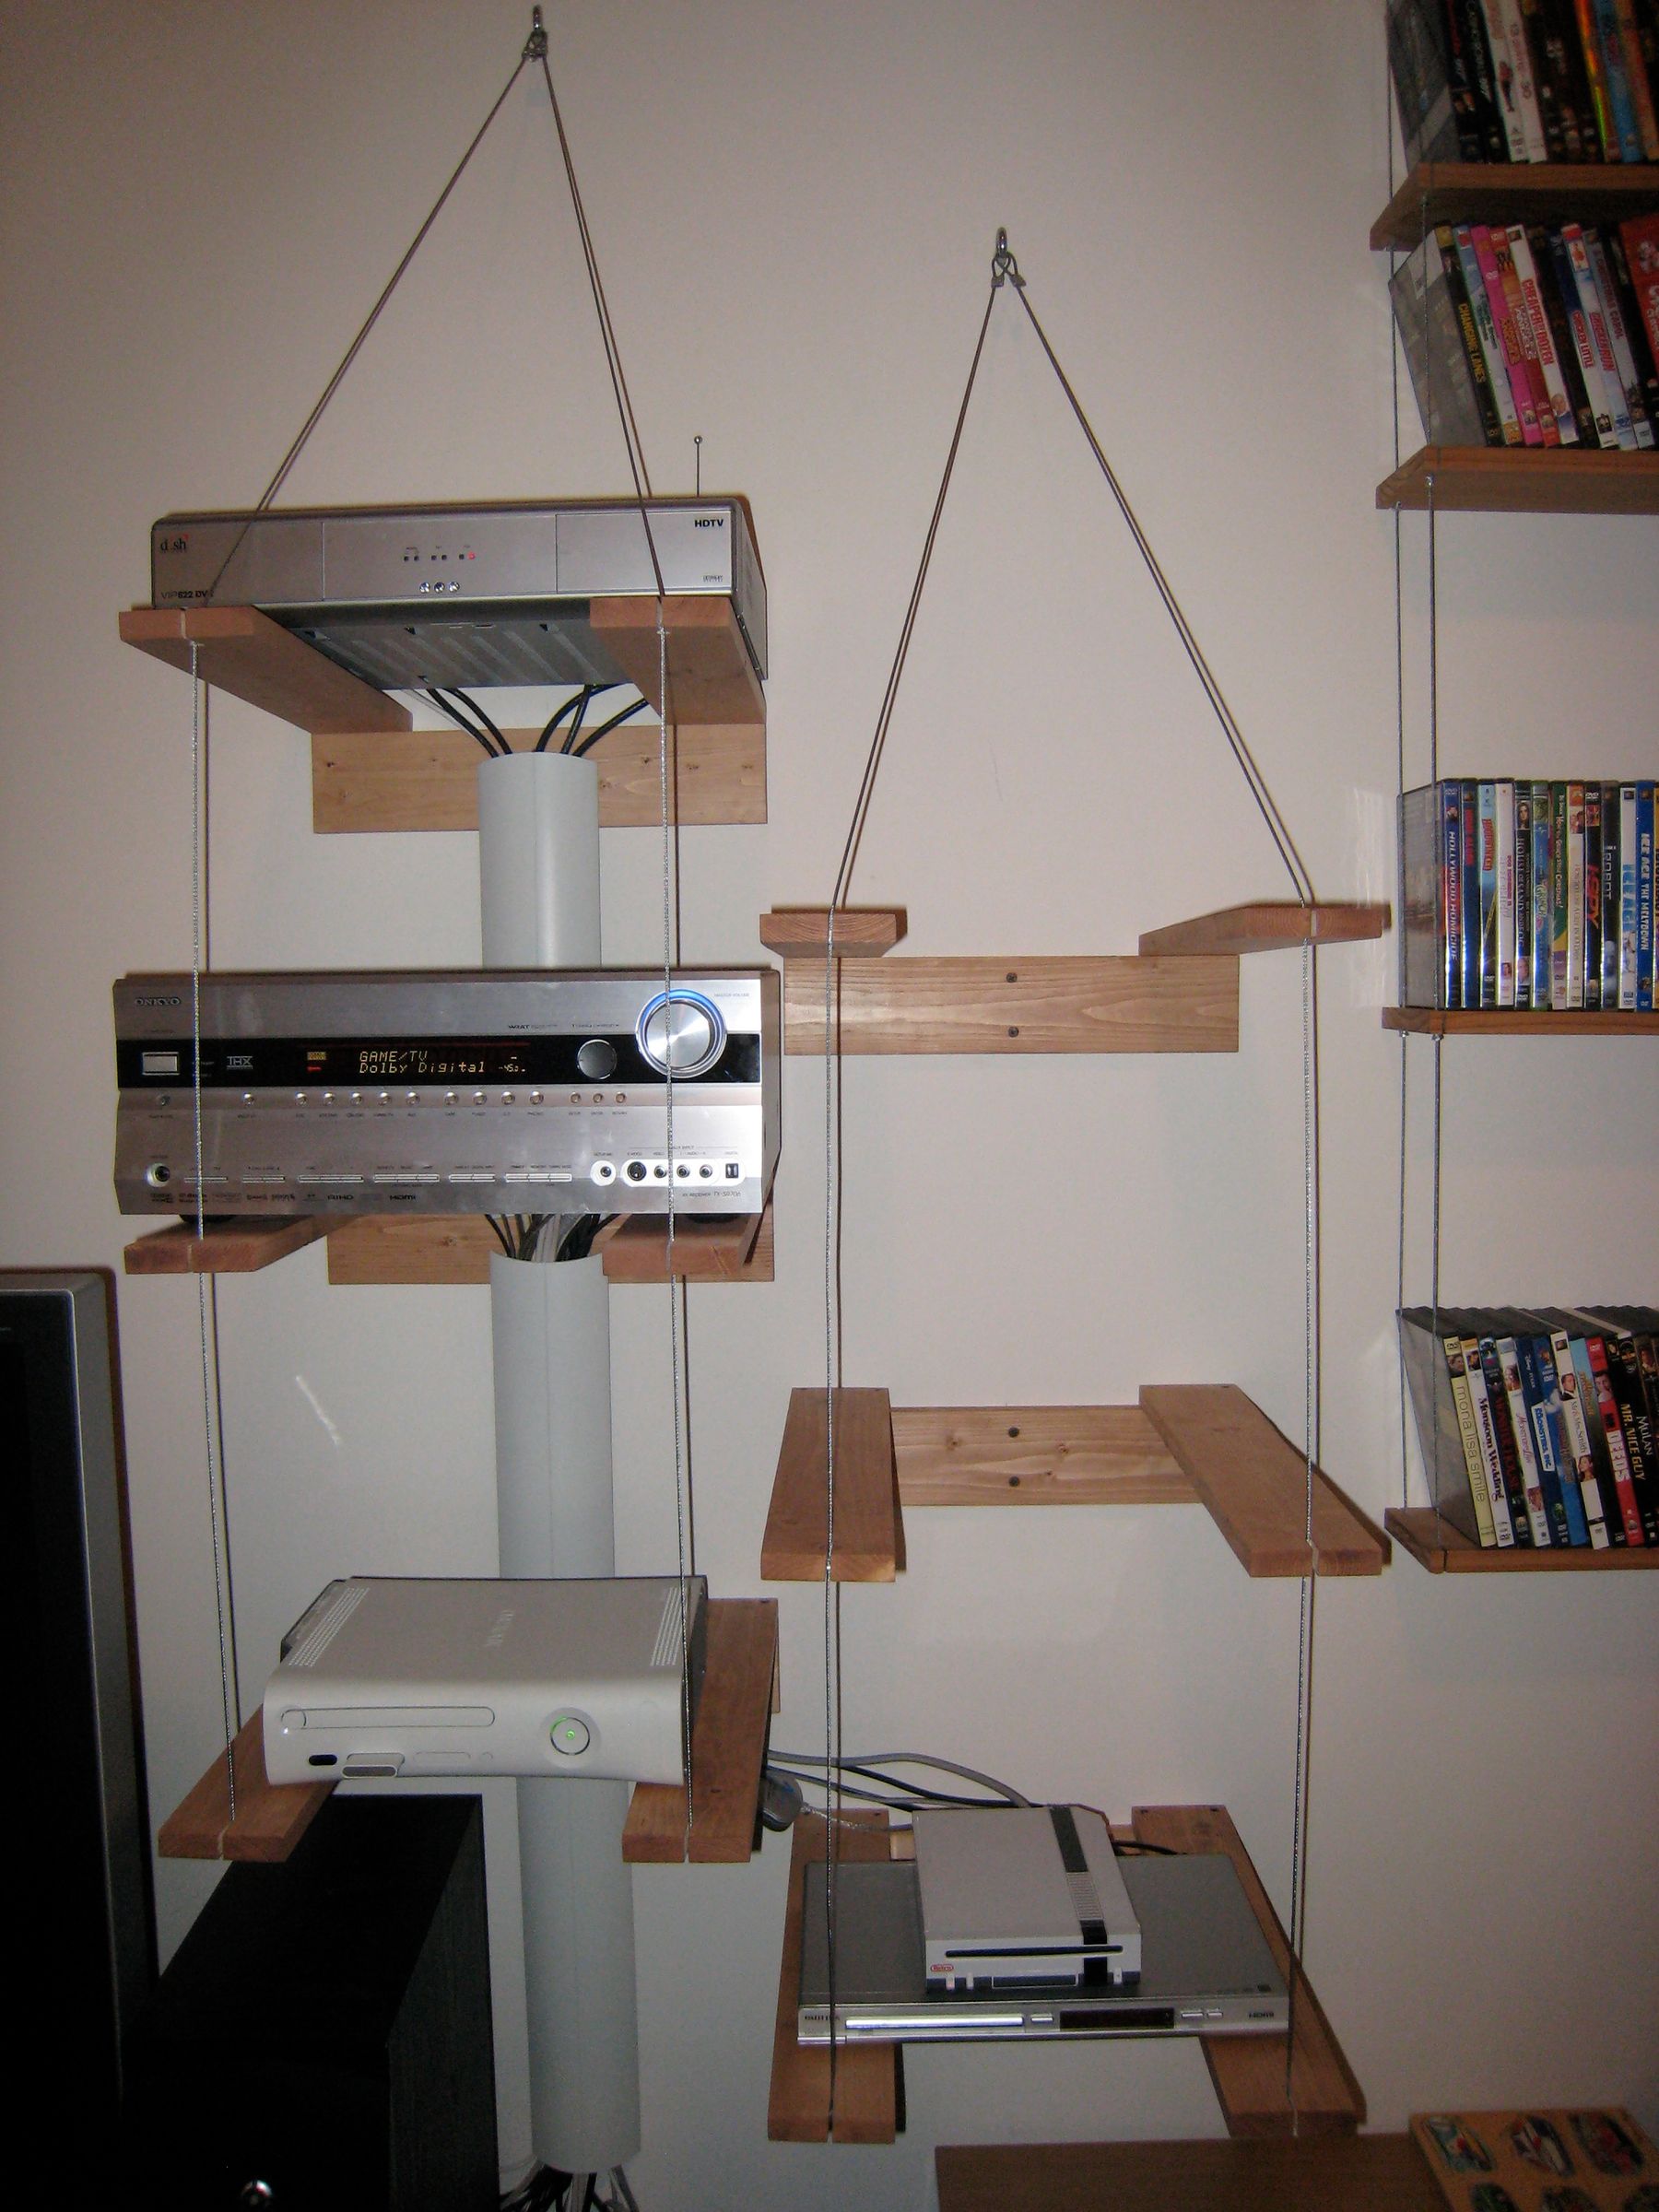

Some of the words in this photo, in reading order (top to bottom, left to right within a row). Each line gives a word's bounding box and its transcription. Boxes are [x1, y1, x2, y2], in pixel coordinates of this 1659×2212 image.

[1522, 279, 1543, 323] CHEAPER
[1536, 331, 1554, 366] DOZEN
[1611, 310, 1624, 340] CAROL
[1458, 303, 1478, 352] CHANGING
[1471, 353, 1486, 383] LANES
[1571, 311, 1588, 345] CHICKEN
[1581, 344, 1594, 369] LITTLE
[1601, 347, 1615, 371] RUN
[695, 519, 724, 528] HDTV
[1641, 833, 1650, 854] ICE
[1449, 830, 1457, 900] HOLLYWOOD
[1641, 856, 1650, 879] AGE
[1622, 865, 1636, 895] ICE
[1641, 883, 1649, 900] THE
[1622, 895, 1636, 932] AGE
[1641, 902, 1649, 950] MELTDOWN
[135, 997, 182, 1006] ONKYO
[227, 1055, 254, 1070] THX
[359, 1051, 429, 1063] GAME/TV
[359, 1062, 408, 1075] Dolby
[418, 1061, 486, 1075] Digital
[1621, 1403, 1633, 1427] MR.
[1456, 1385, 1472, 1430] mona
[1465, 1432, 1477, 1460] lisa
[1471, 1463, 1486, 1503] smile
[1577, 1432, 1587, 1453] Smith
[1627, 1428, 1640, 1454] NICE
[1636, 1416, 1653, 1456] MULAN
[1478, 1397, 1493, 1449] Monsoon
[1488, 1449, 1504, 1502] Wedding
[1631, 1456, 1646, 1481] GUY
